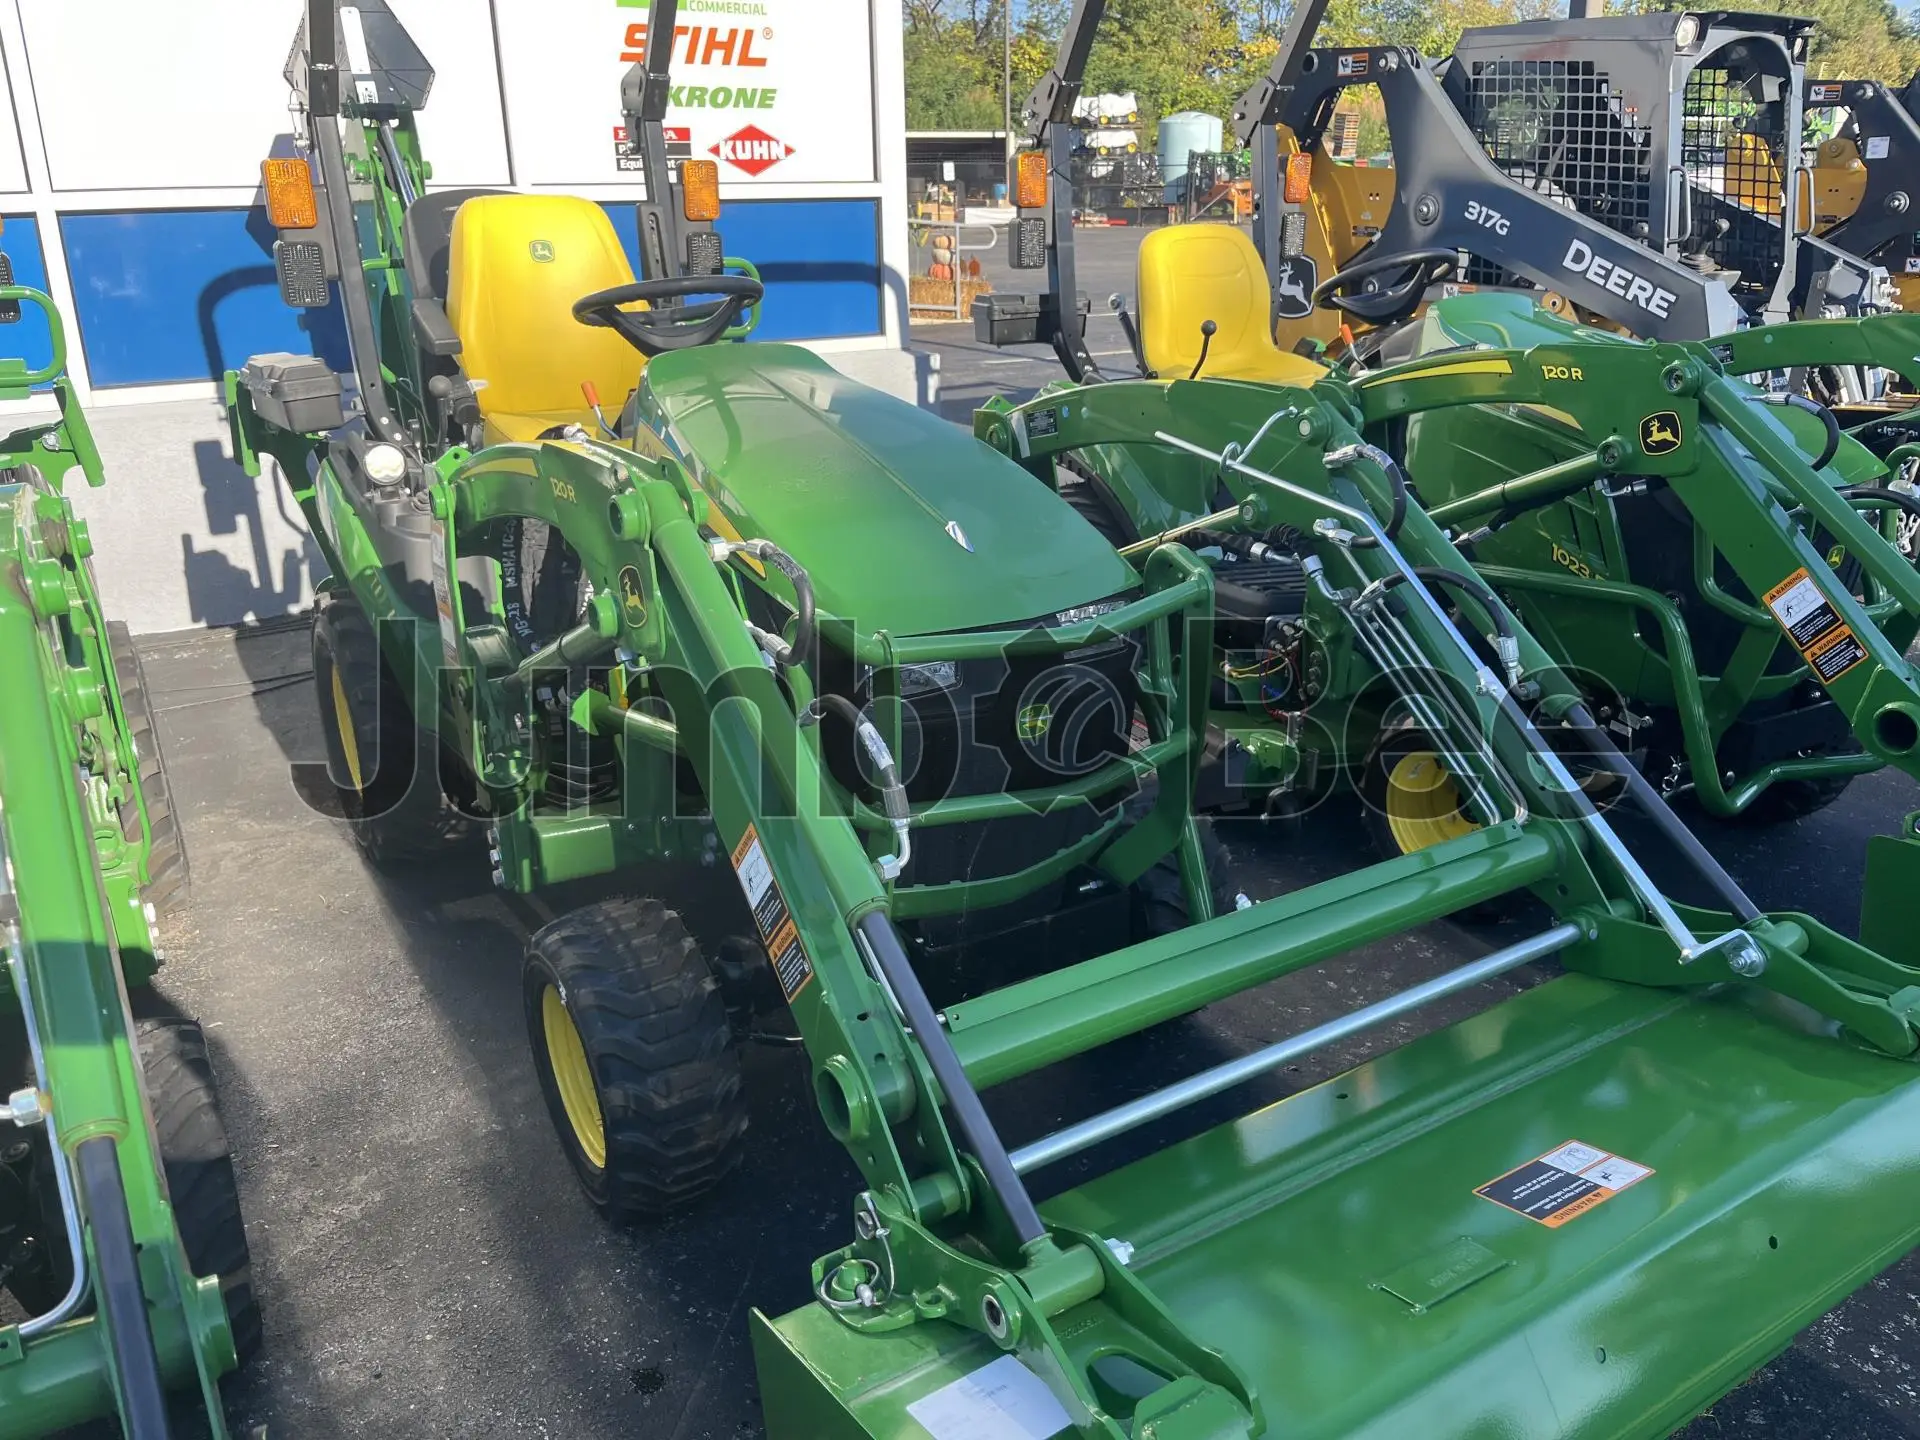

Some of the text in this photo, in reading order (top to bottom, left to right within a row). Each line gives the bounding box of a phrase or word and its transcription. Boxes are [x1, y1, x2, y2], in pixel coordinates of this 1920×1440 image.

[689, 0, 768, 15] COMMERCIAL
[667, 86, 777, 108] KRONE
[719, 140, 786, 161] KUHN
[1464, 200, 1511, 236] 317G
[1562, 238, 1677, 319] DEERE
[1775, 572, 1803, 595] WARNING
[1817, 630, 1846, 652] WARNING
[1553, 1195, 1596, 1220] WARNING
